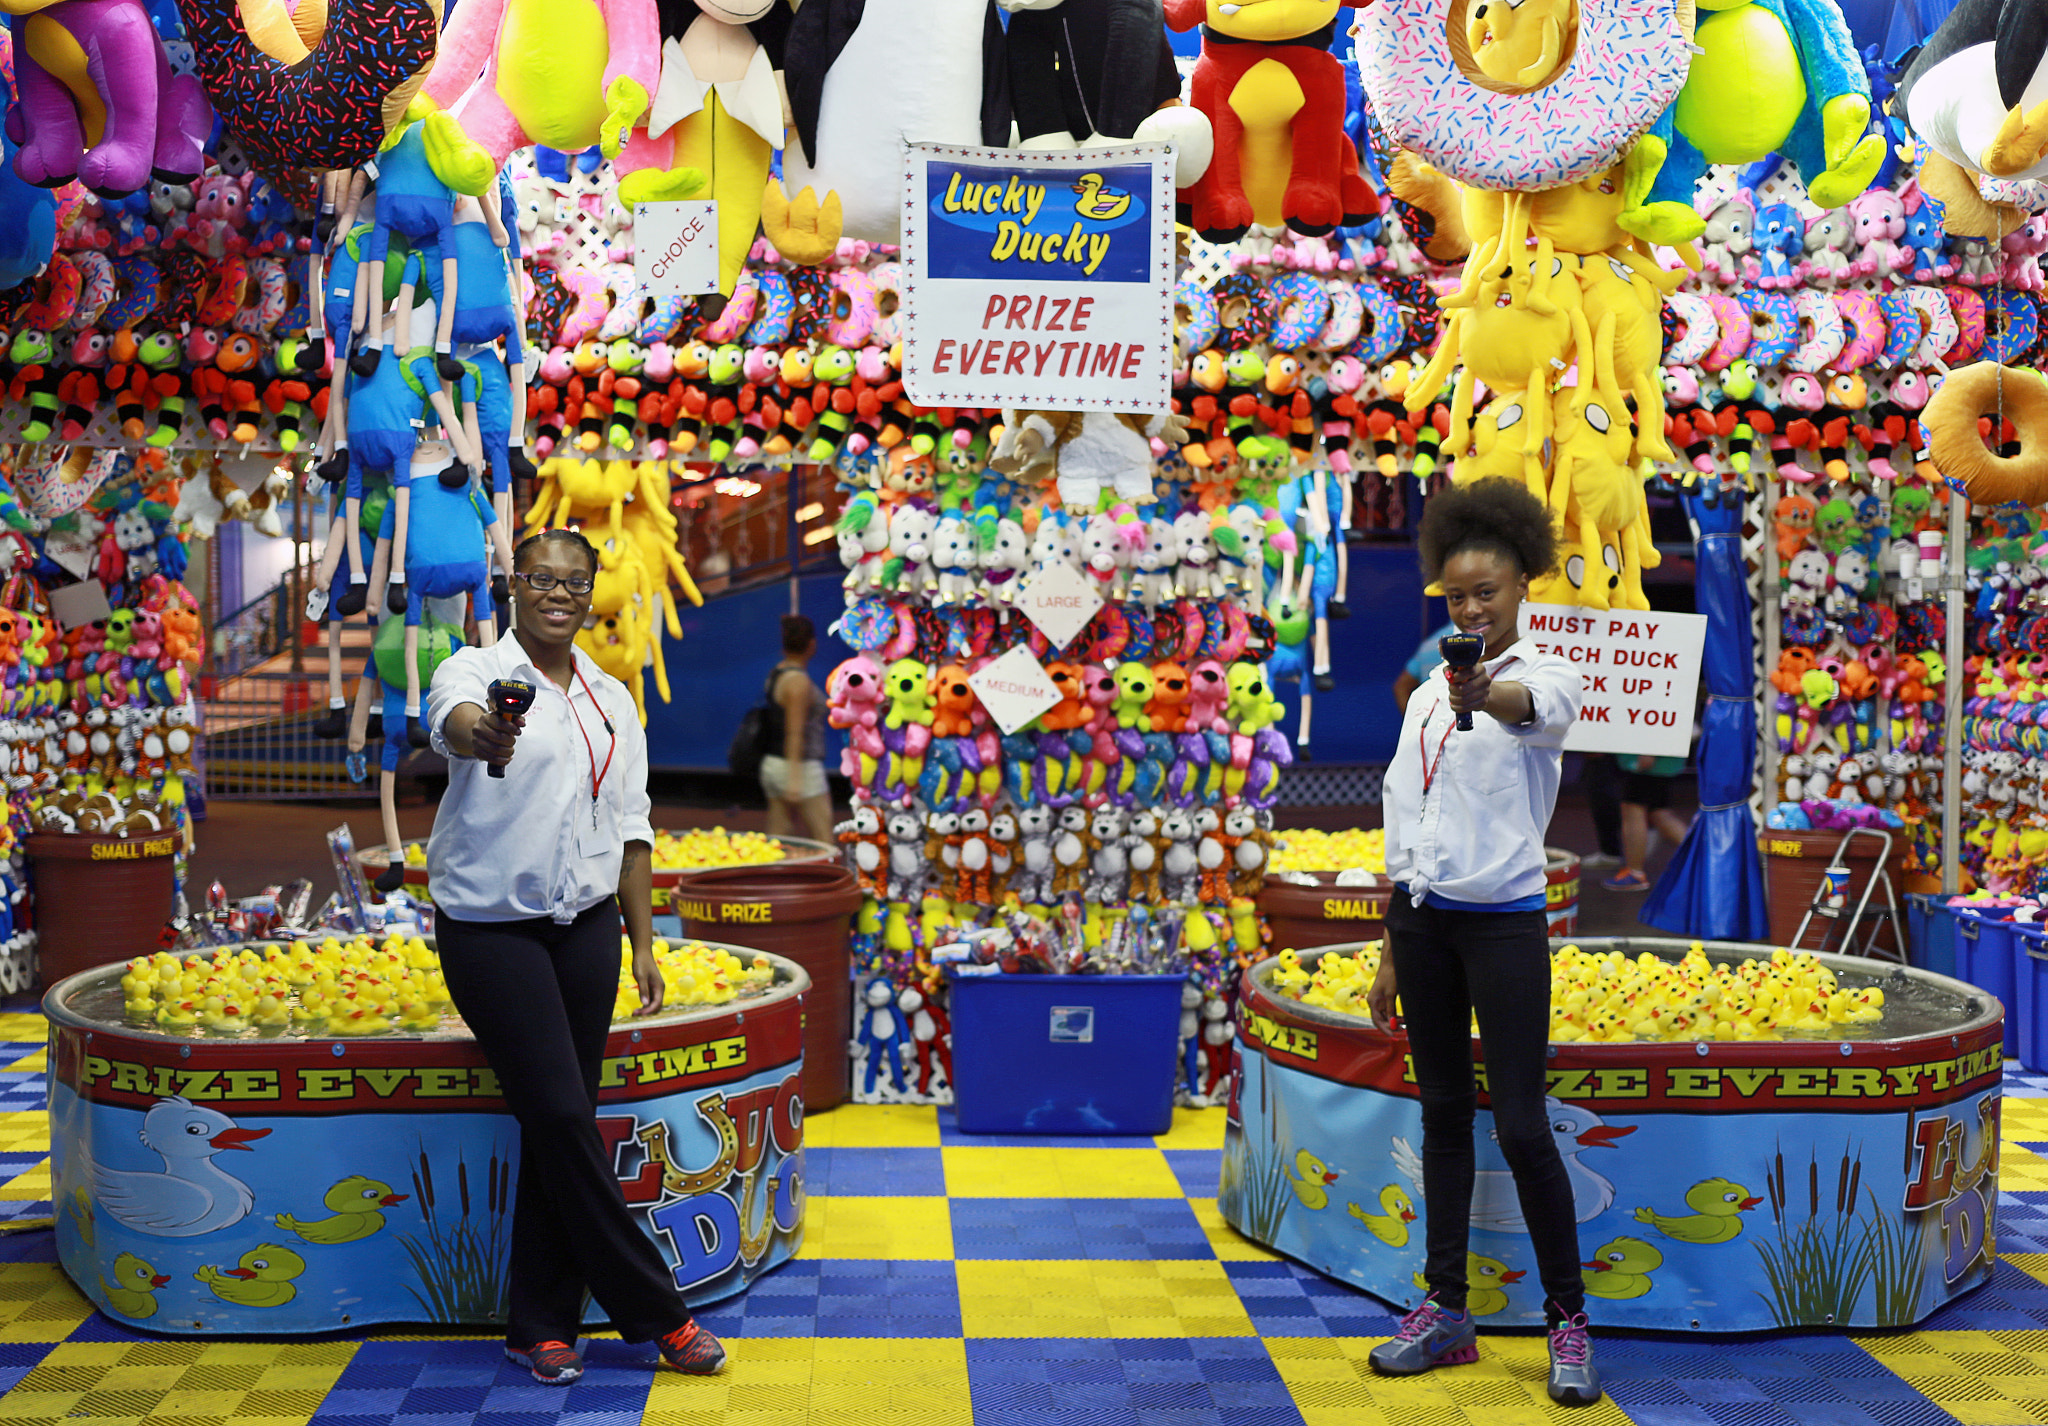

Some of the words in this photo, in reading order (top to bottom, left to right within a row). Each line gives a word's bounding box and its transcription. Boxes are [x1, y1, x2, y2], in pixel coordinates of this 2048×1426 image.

[943, 171, 1047, 226] Lucky
[651, 216, 705, 279] CHOICE
[990, 219, 1111, 276] Ducky
[982, 294, 1095, 332] PRIZE
[932, 338, 1145, 379] EVERYTIME
[1036, 596, 1082, 609] LARGE
[1529, 614, 1596, 635] MUST
[1608, 620, 1659, 640] PAY
[1613, 649, 1678, 670] DUCK
[986, 679, 1045, 699] MEDIUM
[1622, 677, 1653, 695] UP
[1626, 708, 1677, 727] YOU
[91, 843, 140, 860] SMALL
[143, 837, 174, 857] PRIZE
[676, 900, 717, 922] SMALL
[721, 903, 772, 923] PRIZE
[1323, 898, 1383, 919] SMALL
[82, 1055, 280, 1100] PRIZE
[1665, 1041, 2003, 1097] EVERYTIME
